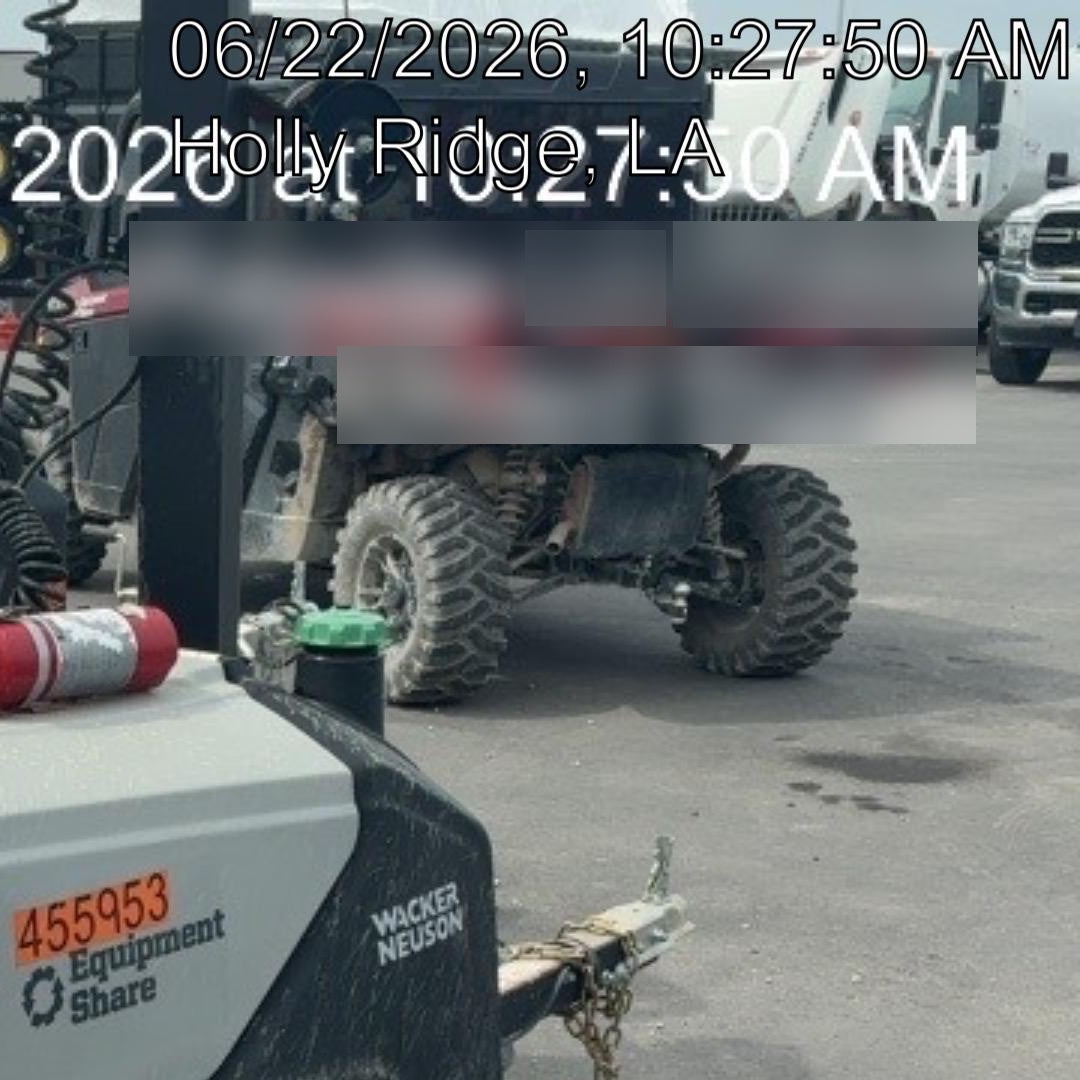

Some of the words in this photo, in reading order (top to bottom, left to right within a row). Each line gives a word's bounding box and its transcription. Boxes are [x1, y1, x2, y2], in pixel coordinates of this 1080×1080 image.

[18, 872, 170, 958] 455953
[371, 881, 460, 937] WACKER
[377, 906, 464, 967] NEUSON
[69, 908, 226, 984] Equipment
[70, 976, 157, 1025] Share
